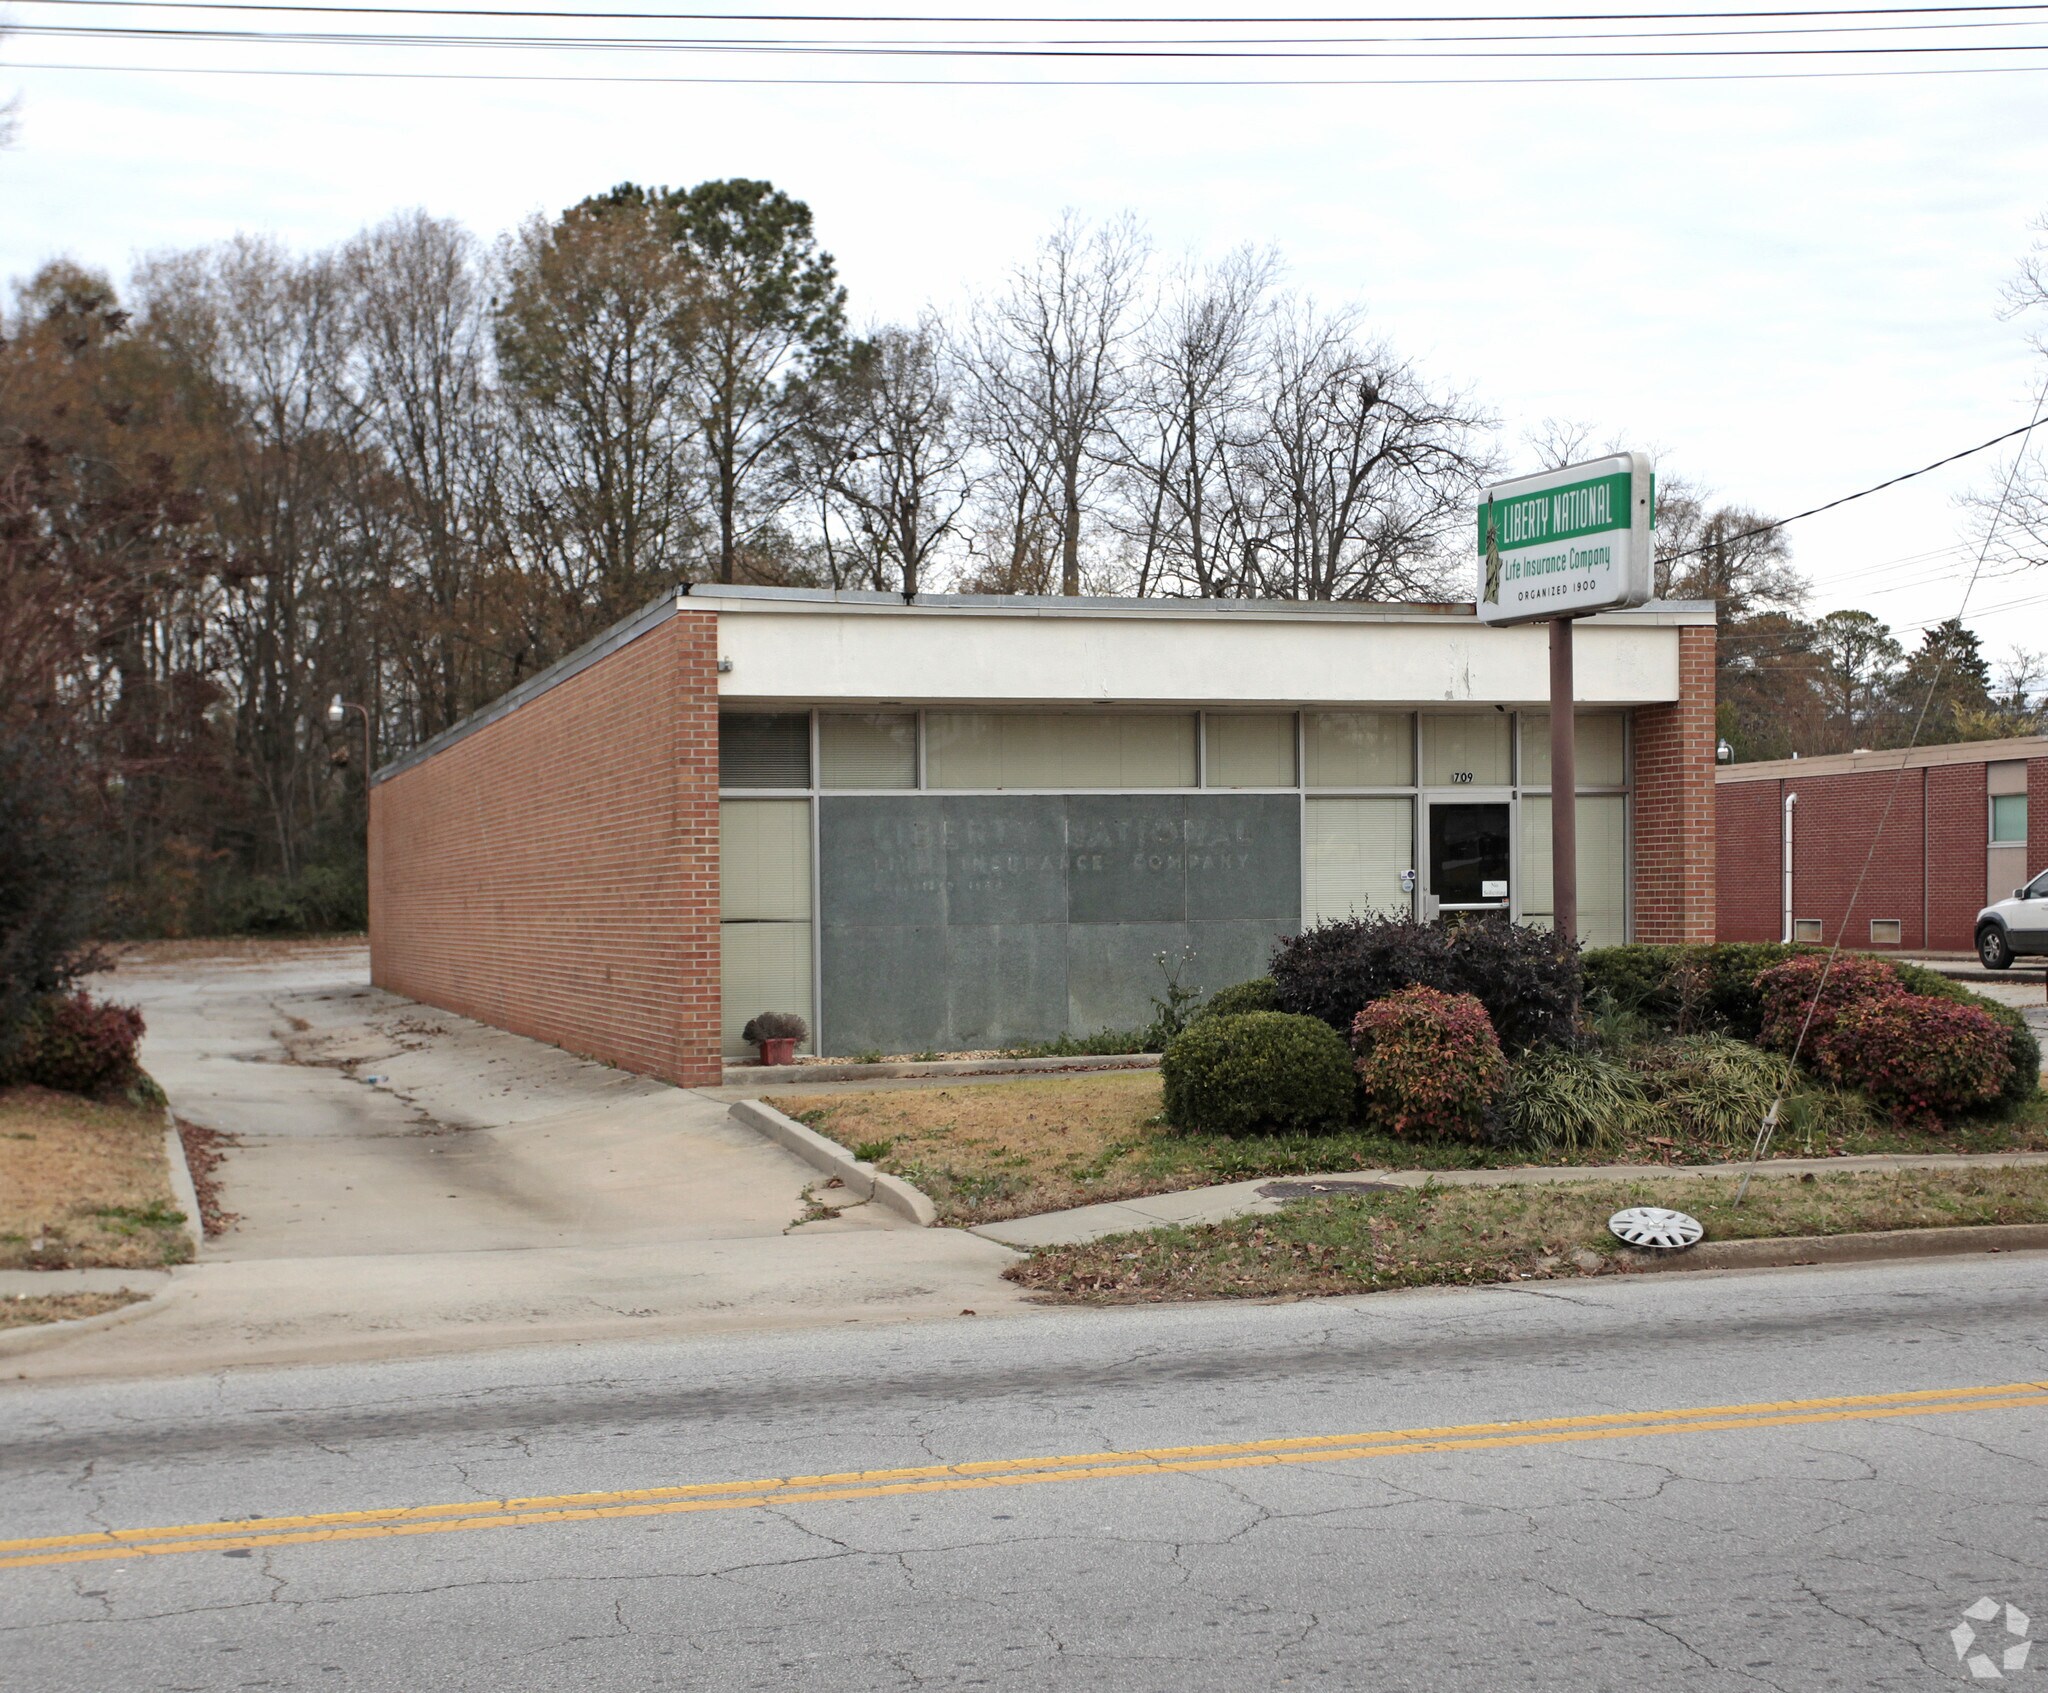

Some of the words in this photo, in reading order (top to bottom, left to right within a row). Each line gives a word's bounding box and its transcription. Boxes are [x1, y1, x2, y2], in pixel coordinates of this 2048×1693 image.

[1503, 497, 1549, 544] LIBERTY
[1553, 483, 1613, 534] NATIONAL
[1505, 558, 1521, 581] Life
[1523, 554, 1567, 578] Insurance
[1569, 546, 1611, 573] Company
[1518, 584, 1568, 601] ORGANIZED
[1573, 579, 1597, 593] 1900
[1454, 772, 1473, 783] 709
[1133, 853, 1250, 871] COMPANY
